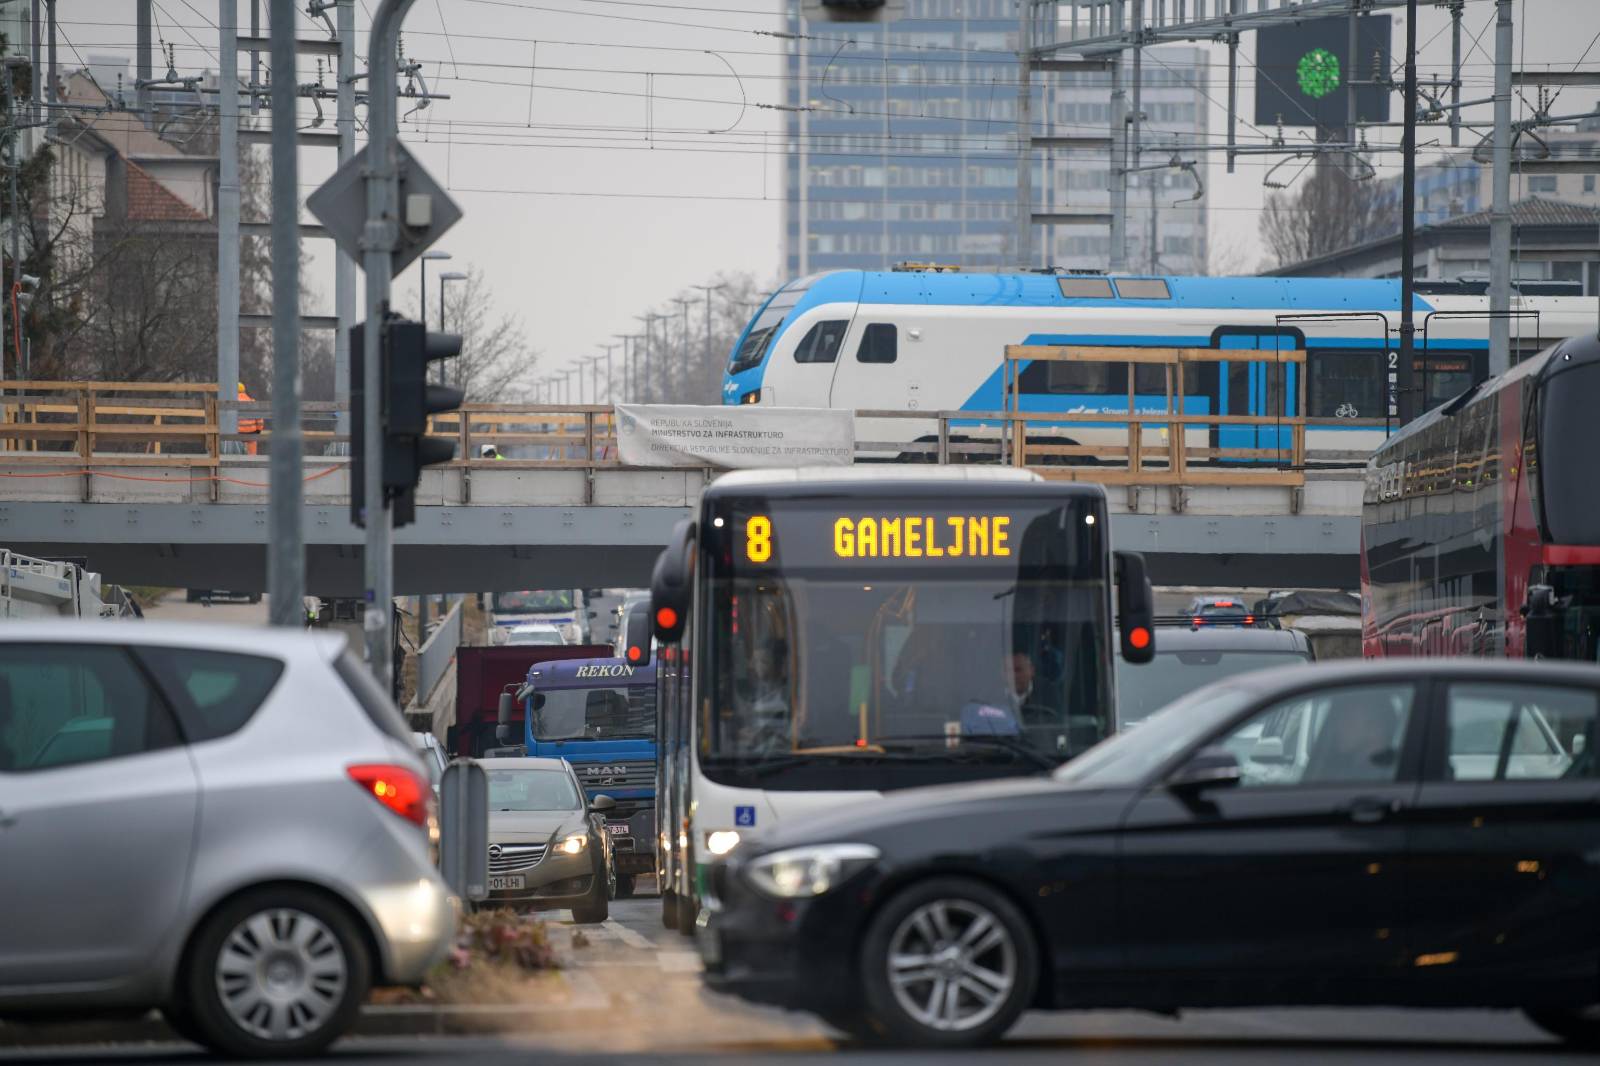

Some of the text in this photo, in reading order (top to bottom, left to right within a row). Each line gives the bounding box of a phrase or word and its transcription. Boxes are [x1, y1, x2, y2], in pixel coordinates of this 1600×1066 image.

[1388, 352, 1398, 369] 2
[694, 419, 733, 428] SLOVENIJA
[651, 429, 784, 439] MINISTRSTVO ZA INFRASTRUKTURO
[733, 446, 769, 455] SLOVENIJE
[771, 447, 782, 455] ZA
[785, 447, 850, 457] INFRASTRUKTURO
[746, 515, 1011, 563] 8 GAMELJNE
[576, 665, 635, 678] REKON
[586, 766, 627, 776] MAN
